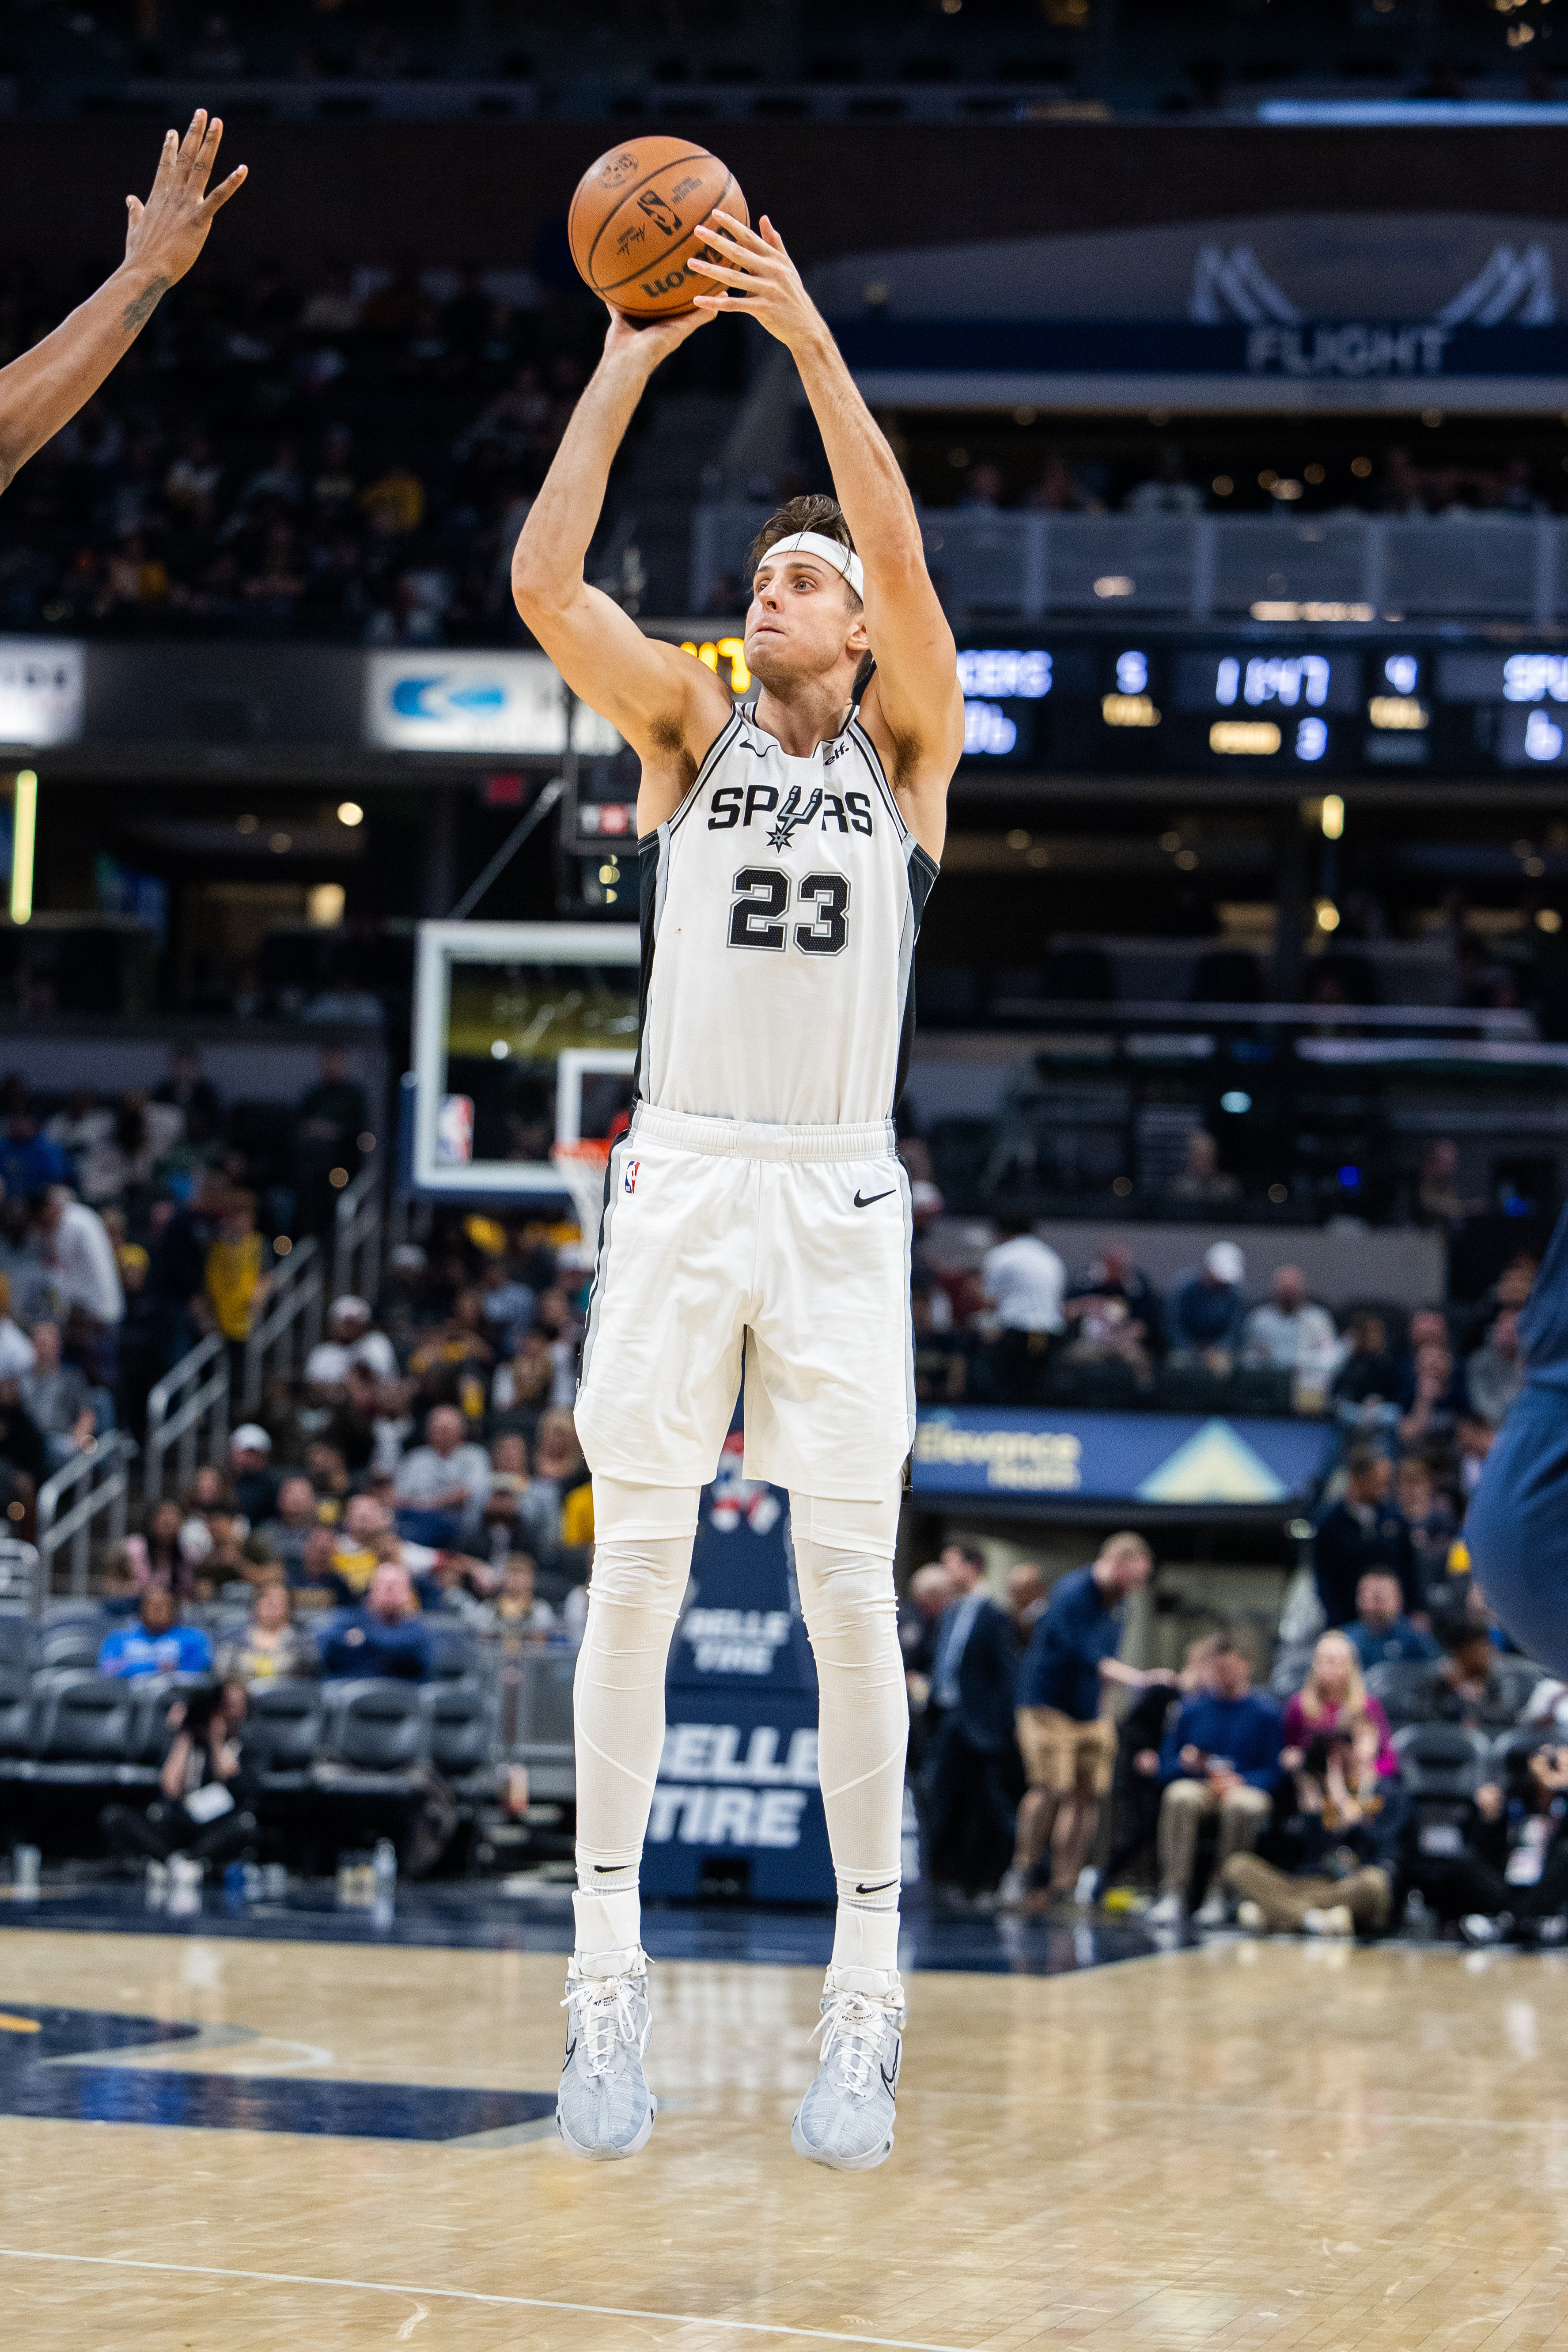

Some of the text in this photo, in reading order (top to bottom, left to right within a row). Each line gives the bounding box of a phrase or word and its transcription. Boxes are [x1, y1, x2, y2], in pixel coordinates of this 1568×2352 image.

[823, 741, 850, 766] elf.
[708, 785, 873, 838] SPURS
[727, 865, 852, 957] 23
[646, 1787, 807, 1849] TIRE
